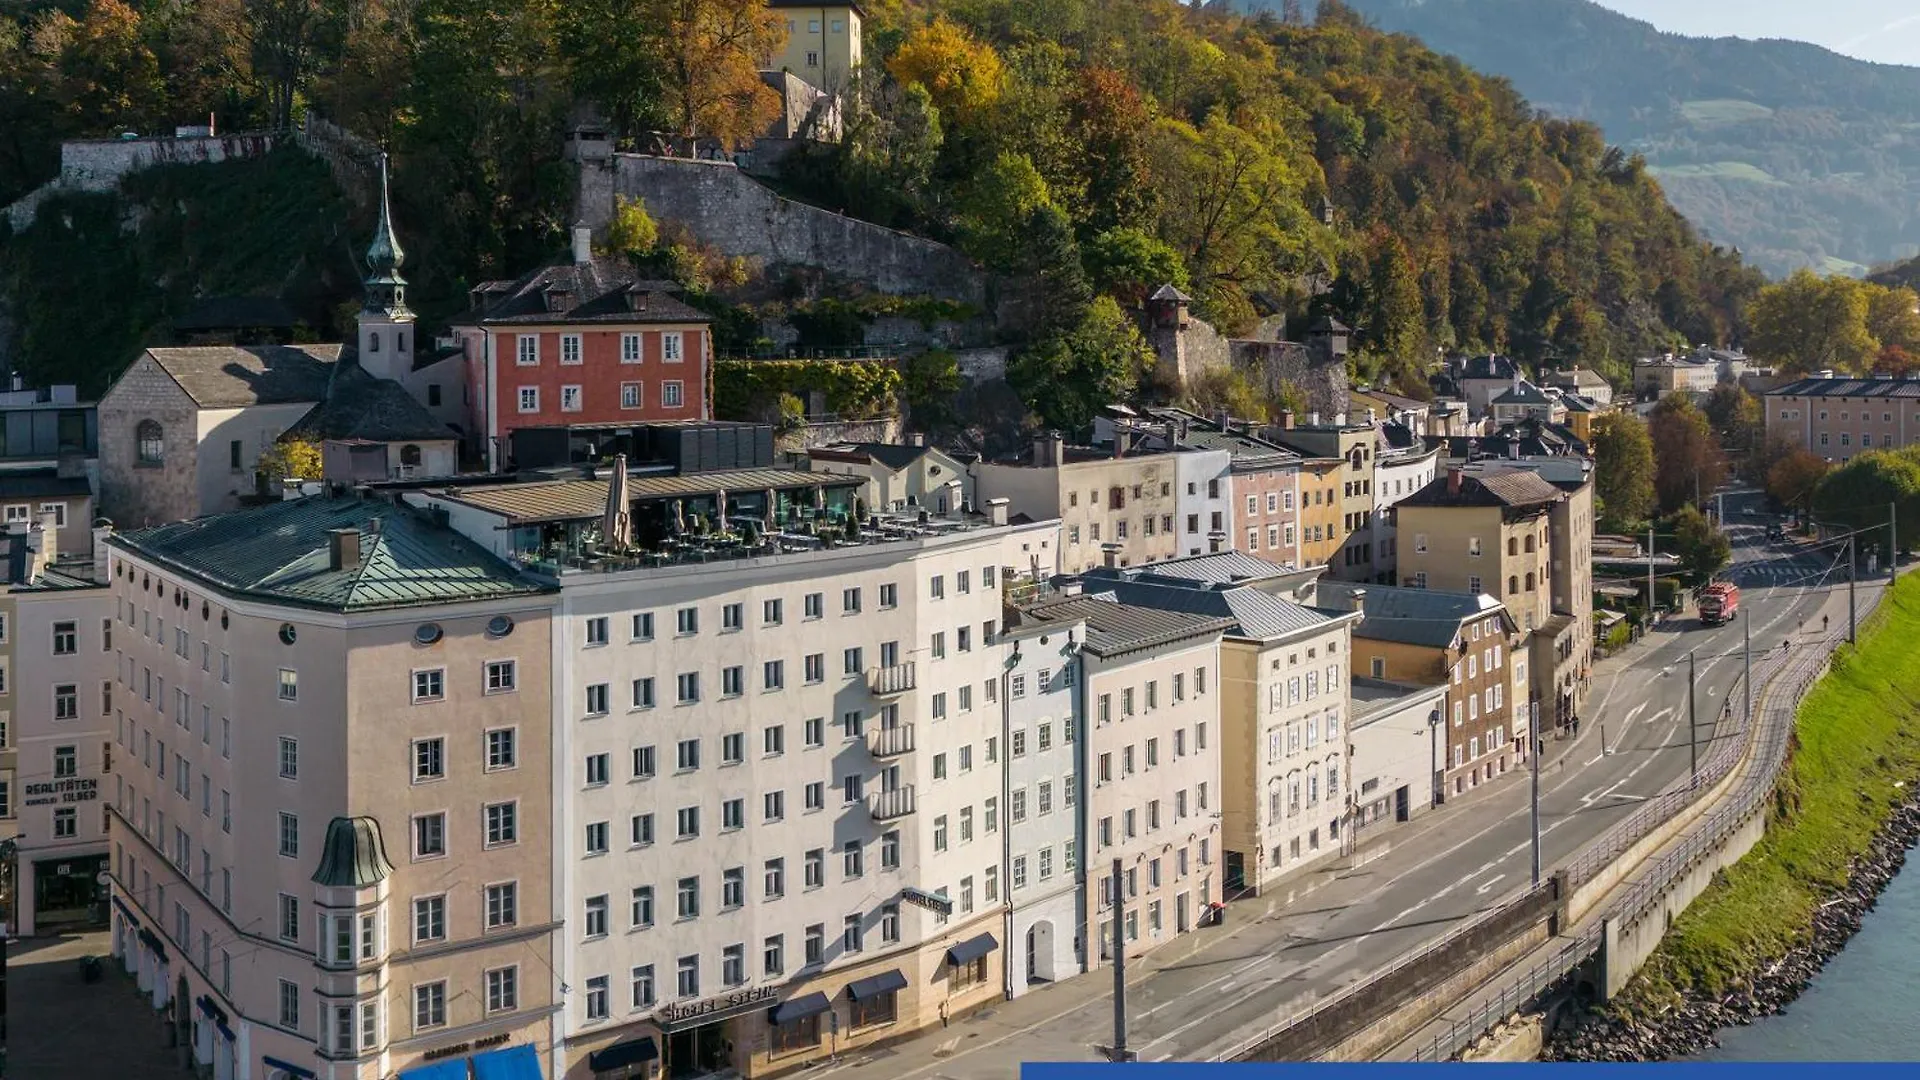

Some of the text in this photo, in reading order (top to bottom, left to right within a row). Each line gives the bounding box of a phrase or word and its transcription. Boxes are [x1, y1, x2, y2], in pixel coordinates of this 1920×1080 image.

[25, 779, 97, 795] REALITÄTEN
[63, 790, 97, 803] SILBER
[668, 986, 774, 1019] HOTEL STEIN
